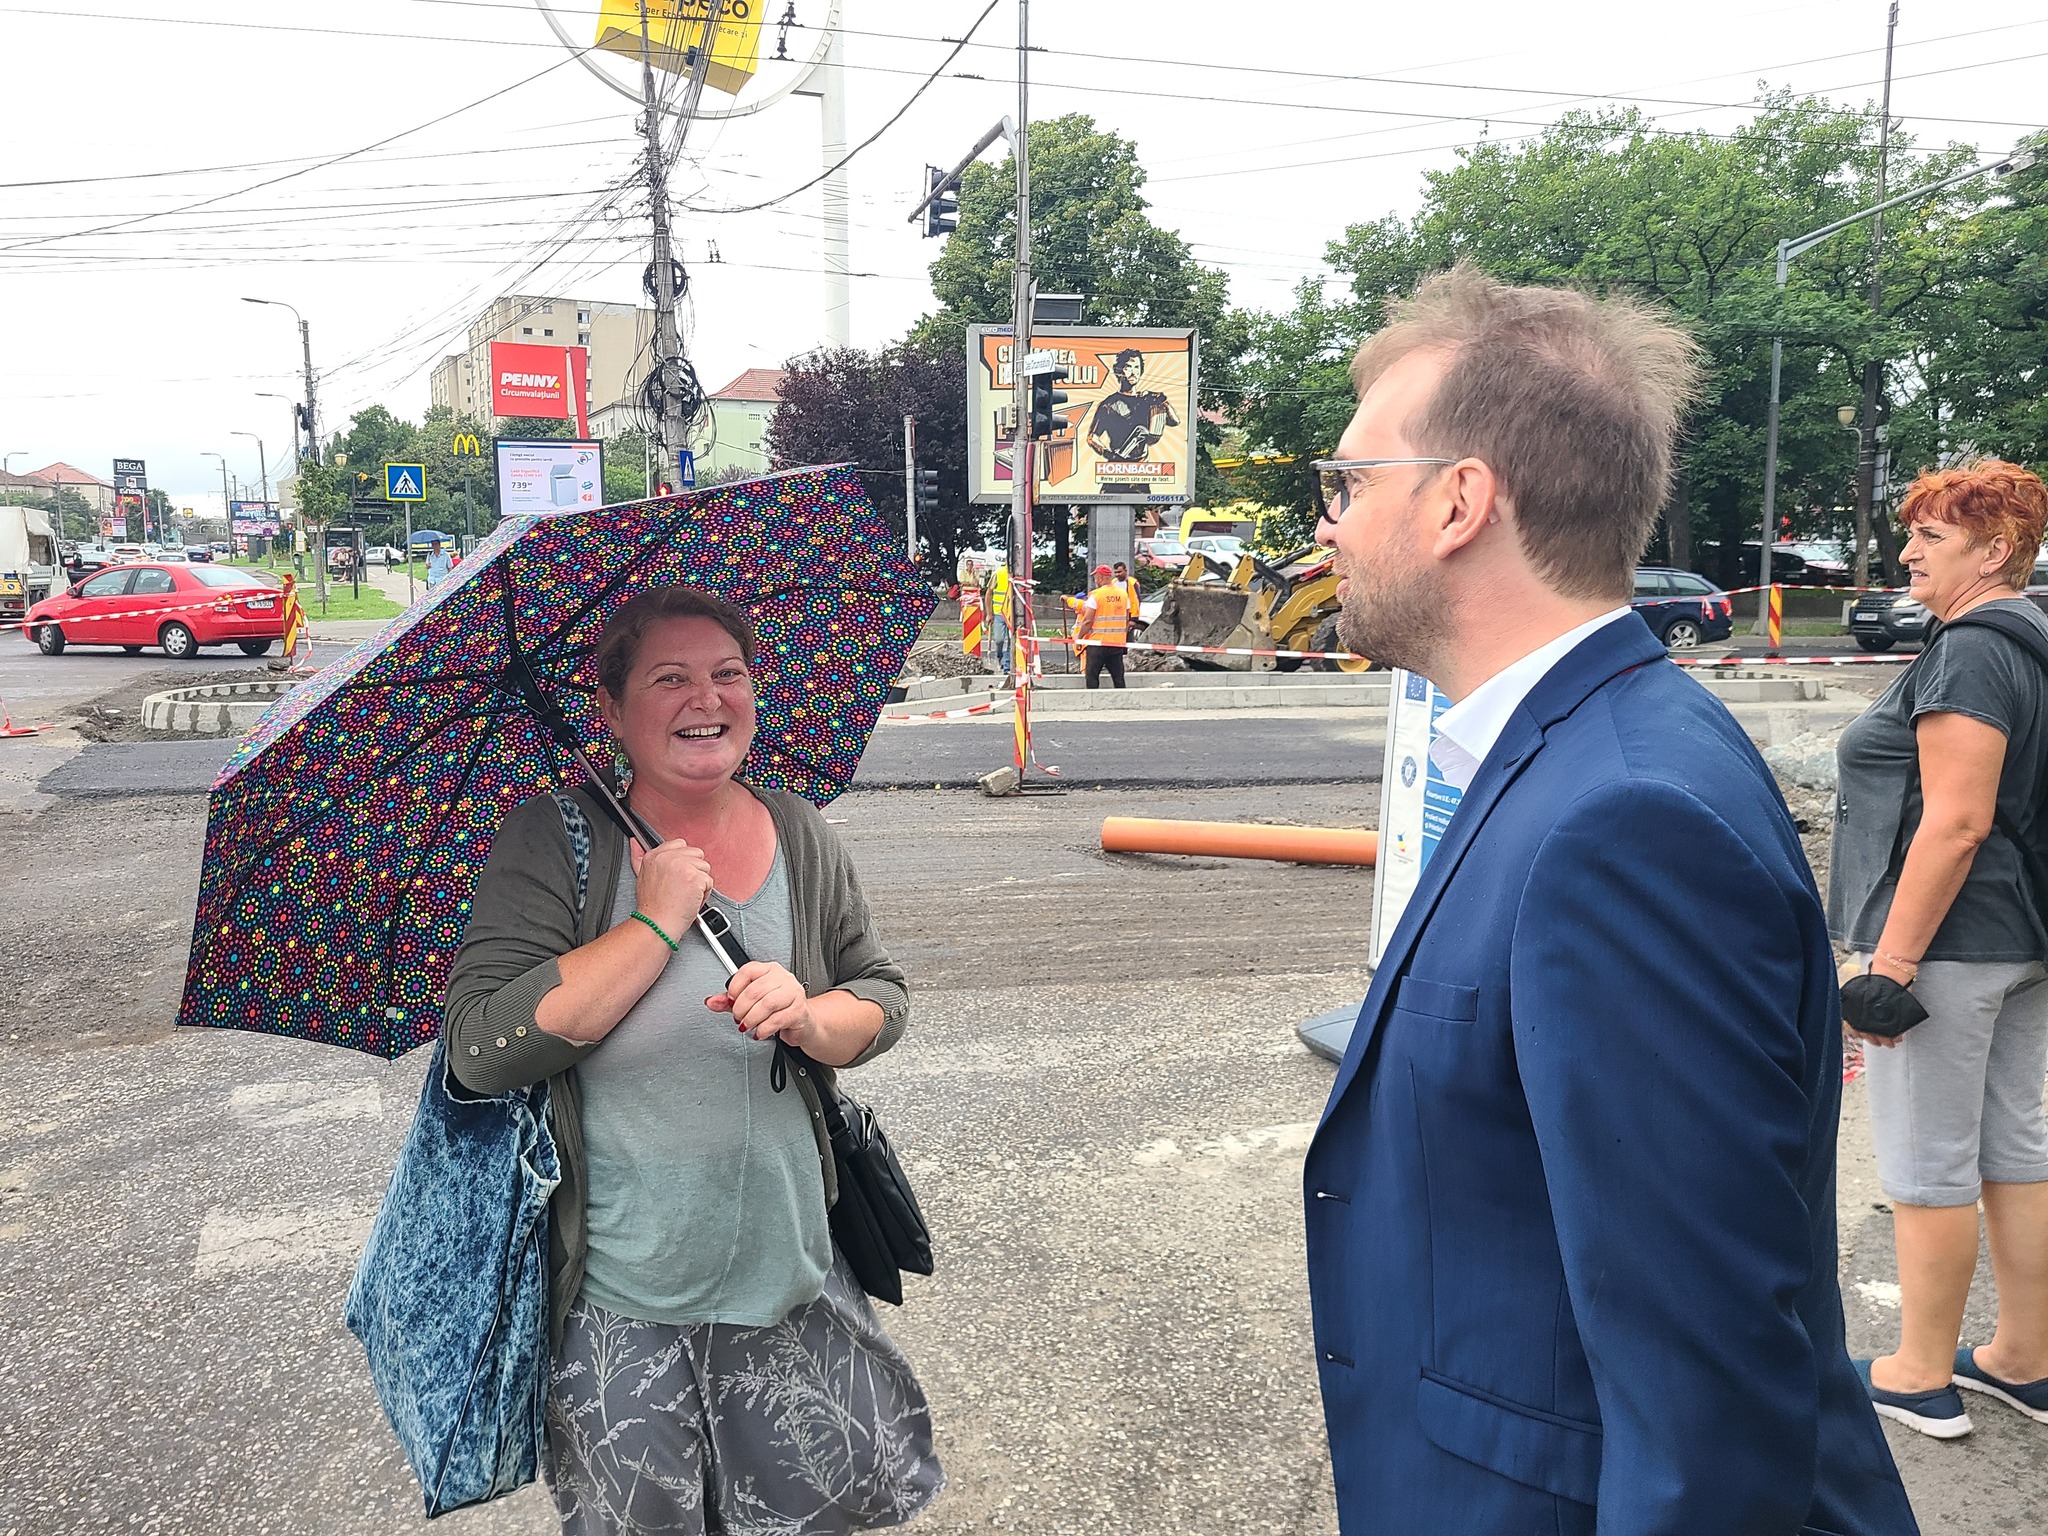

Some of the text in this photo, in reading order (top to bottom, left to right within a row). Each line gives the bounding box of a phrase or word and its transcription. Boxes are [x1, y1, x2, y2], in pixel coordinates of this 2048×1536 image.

[634, 3, 662, 17] Sper
[116, 461, 143, 470] BEGA
[1097, 463, 1161, 474] HORNBACH
